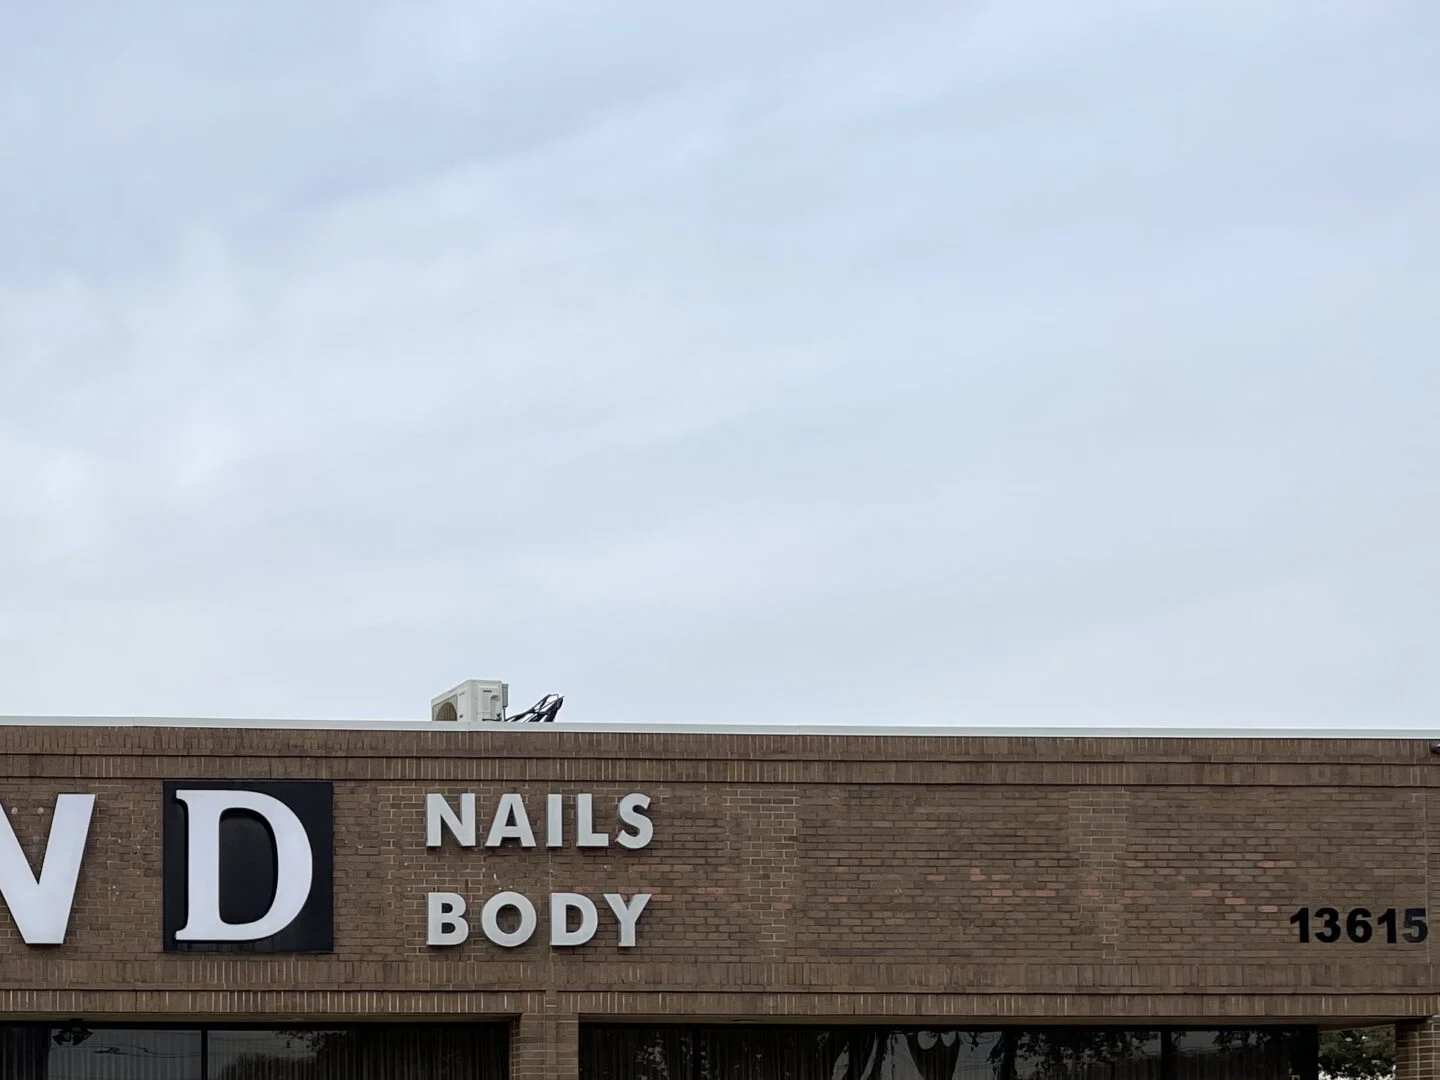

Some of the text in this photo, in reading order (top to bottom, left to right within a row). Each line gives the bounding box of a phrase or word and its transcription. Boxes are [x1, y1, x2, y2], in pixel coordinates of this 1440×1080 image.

[425, 792, 655, 850] NAILS
[175, 789, 313, 941] D
[425, 890, 654, 948] BODY
[1289, 907, 1429, 944] 13615
